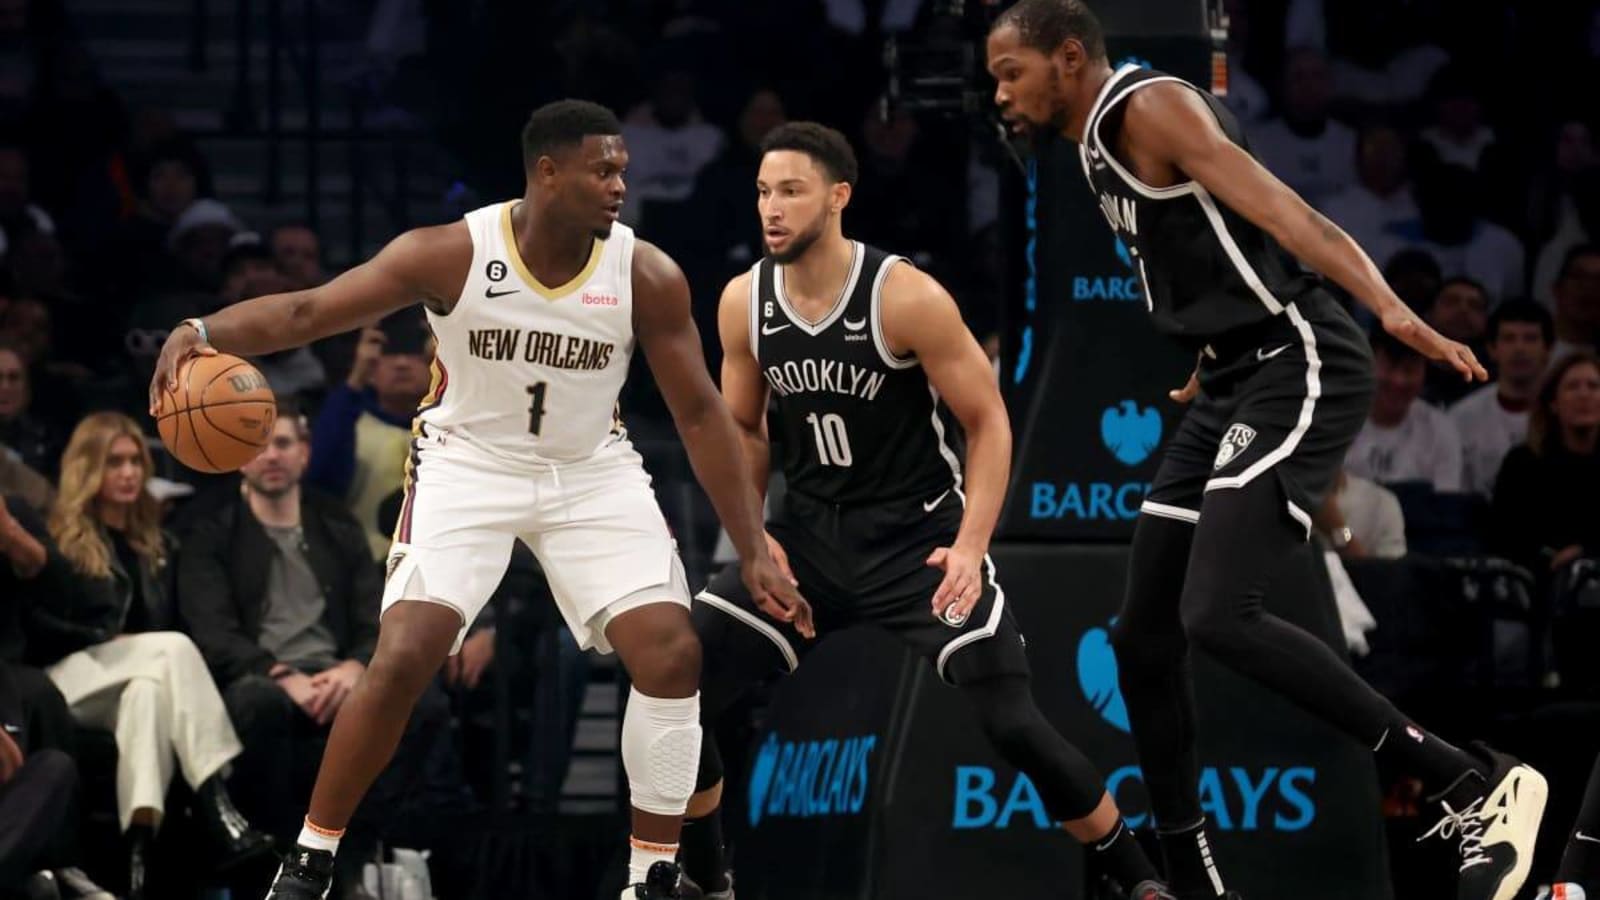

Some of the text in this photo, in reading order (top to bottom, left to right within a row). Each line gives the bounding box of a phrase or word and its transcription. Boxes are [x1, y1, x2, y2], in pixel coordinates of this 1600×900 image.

[490, 262, 503, 280] 6
[1072, 276, 1139, 299] BARC
[581, 292, 618, 306] ibotta
[763, 301, 774, 318] 6
[468, 329, 614, 371] NEW ORLEANS
[525, 381, 547, 437] 1
[806, 412, 853, 467] 10
[1030, 482, 1152, 519] BARC
[767, 735, 877, 817] BARCLAYS
[952, 765, 1317, 831] BACAYS
